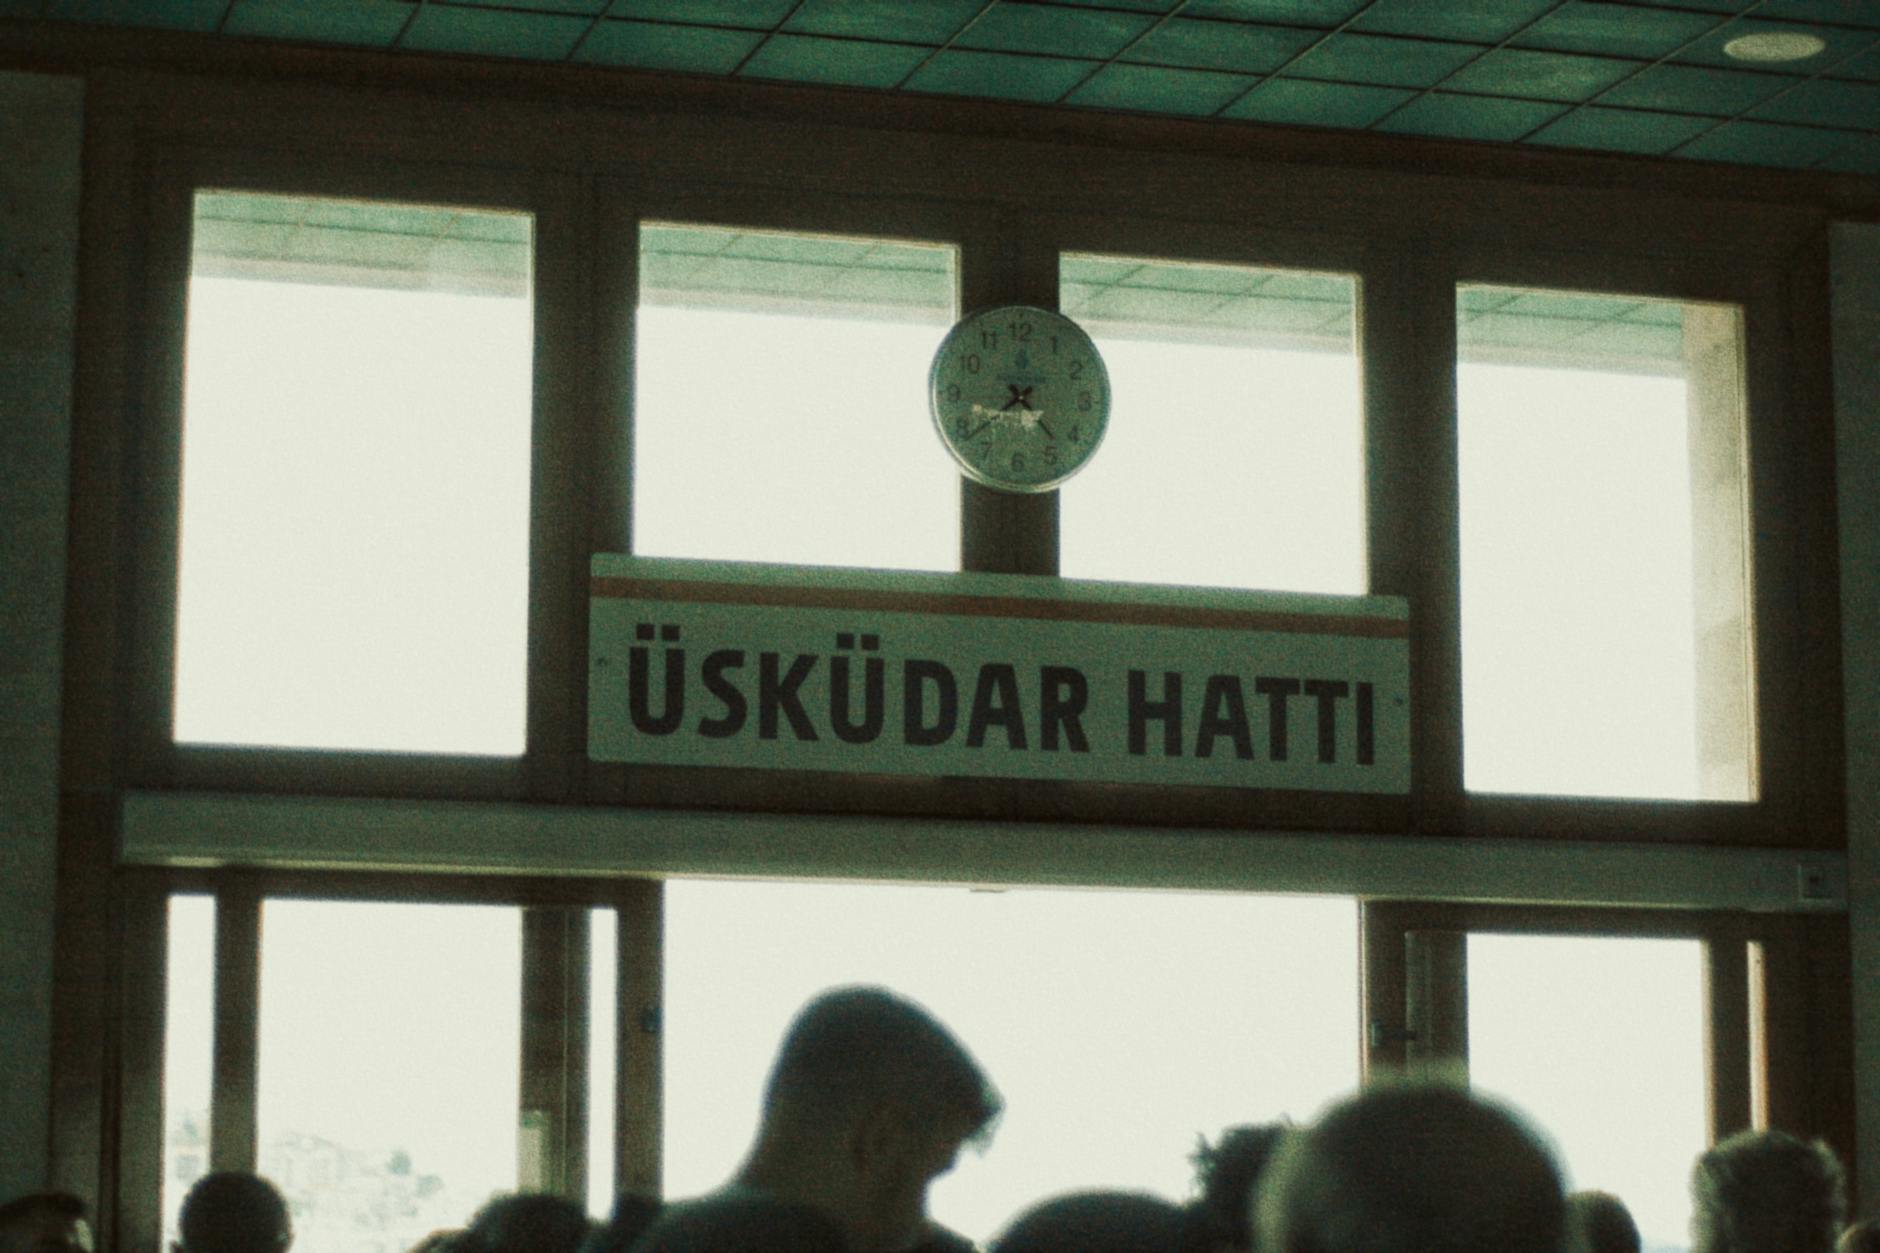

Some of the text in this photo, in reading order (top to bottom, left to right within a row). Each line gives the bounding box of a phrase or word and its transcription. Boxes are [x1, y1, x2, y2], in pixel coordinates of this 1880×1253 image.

[982, 330, 997, 349] 11
[1009, 322, 1032, 342] 12
[1050, 336, 1058, 354] 1
[959, 354, 980, 374] 10
[1069, 361, 1082, 380] 2
[947, 385, 960, 403] 9
[1078, 392, 1092, 411] 3
[956, 418, 969, 438] 8
[1068, 425, 1080, 443] 4
[980, 441, 992, 460] 7
[1044, 446, 1057, 464] 5
[1011, 453, 1024, 472] 6
[627, 623, 1375, 765] ÜSKÜDAR HATTI
